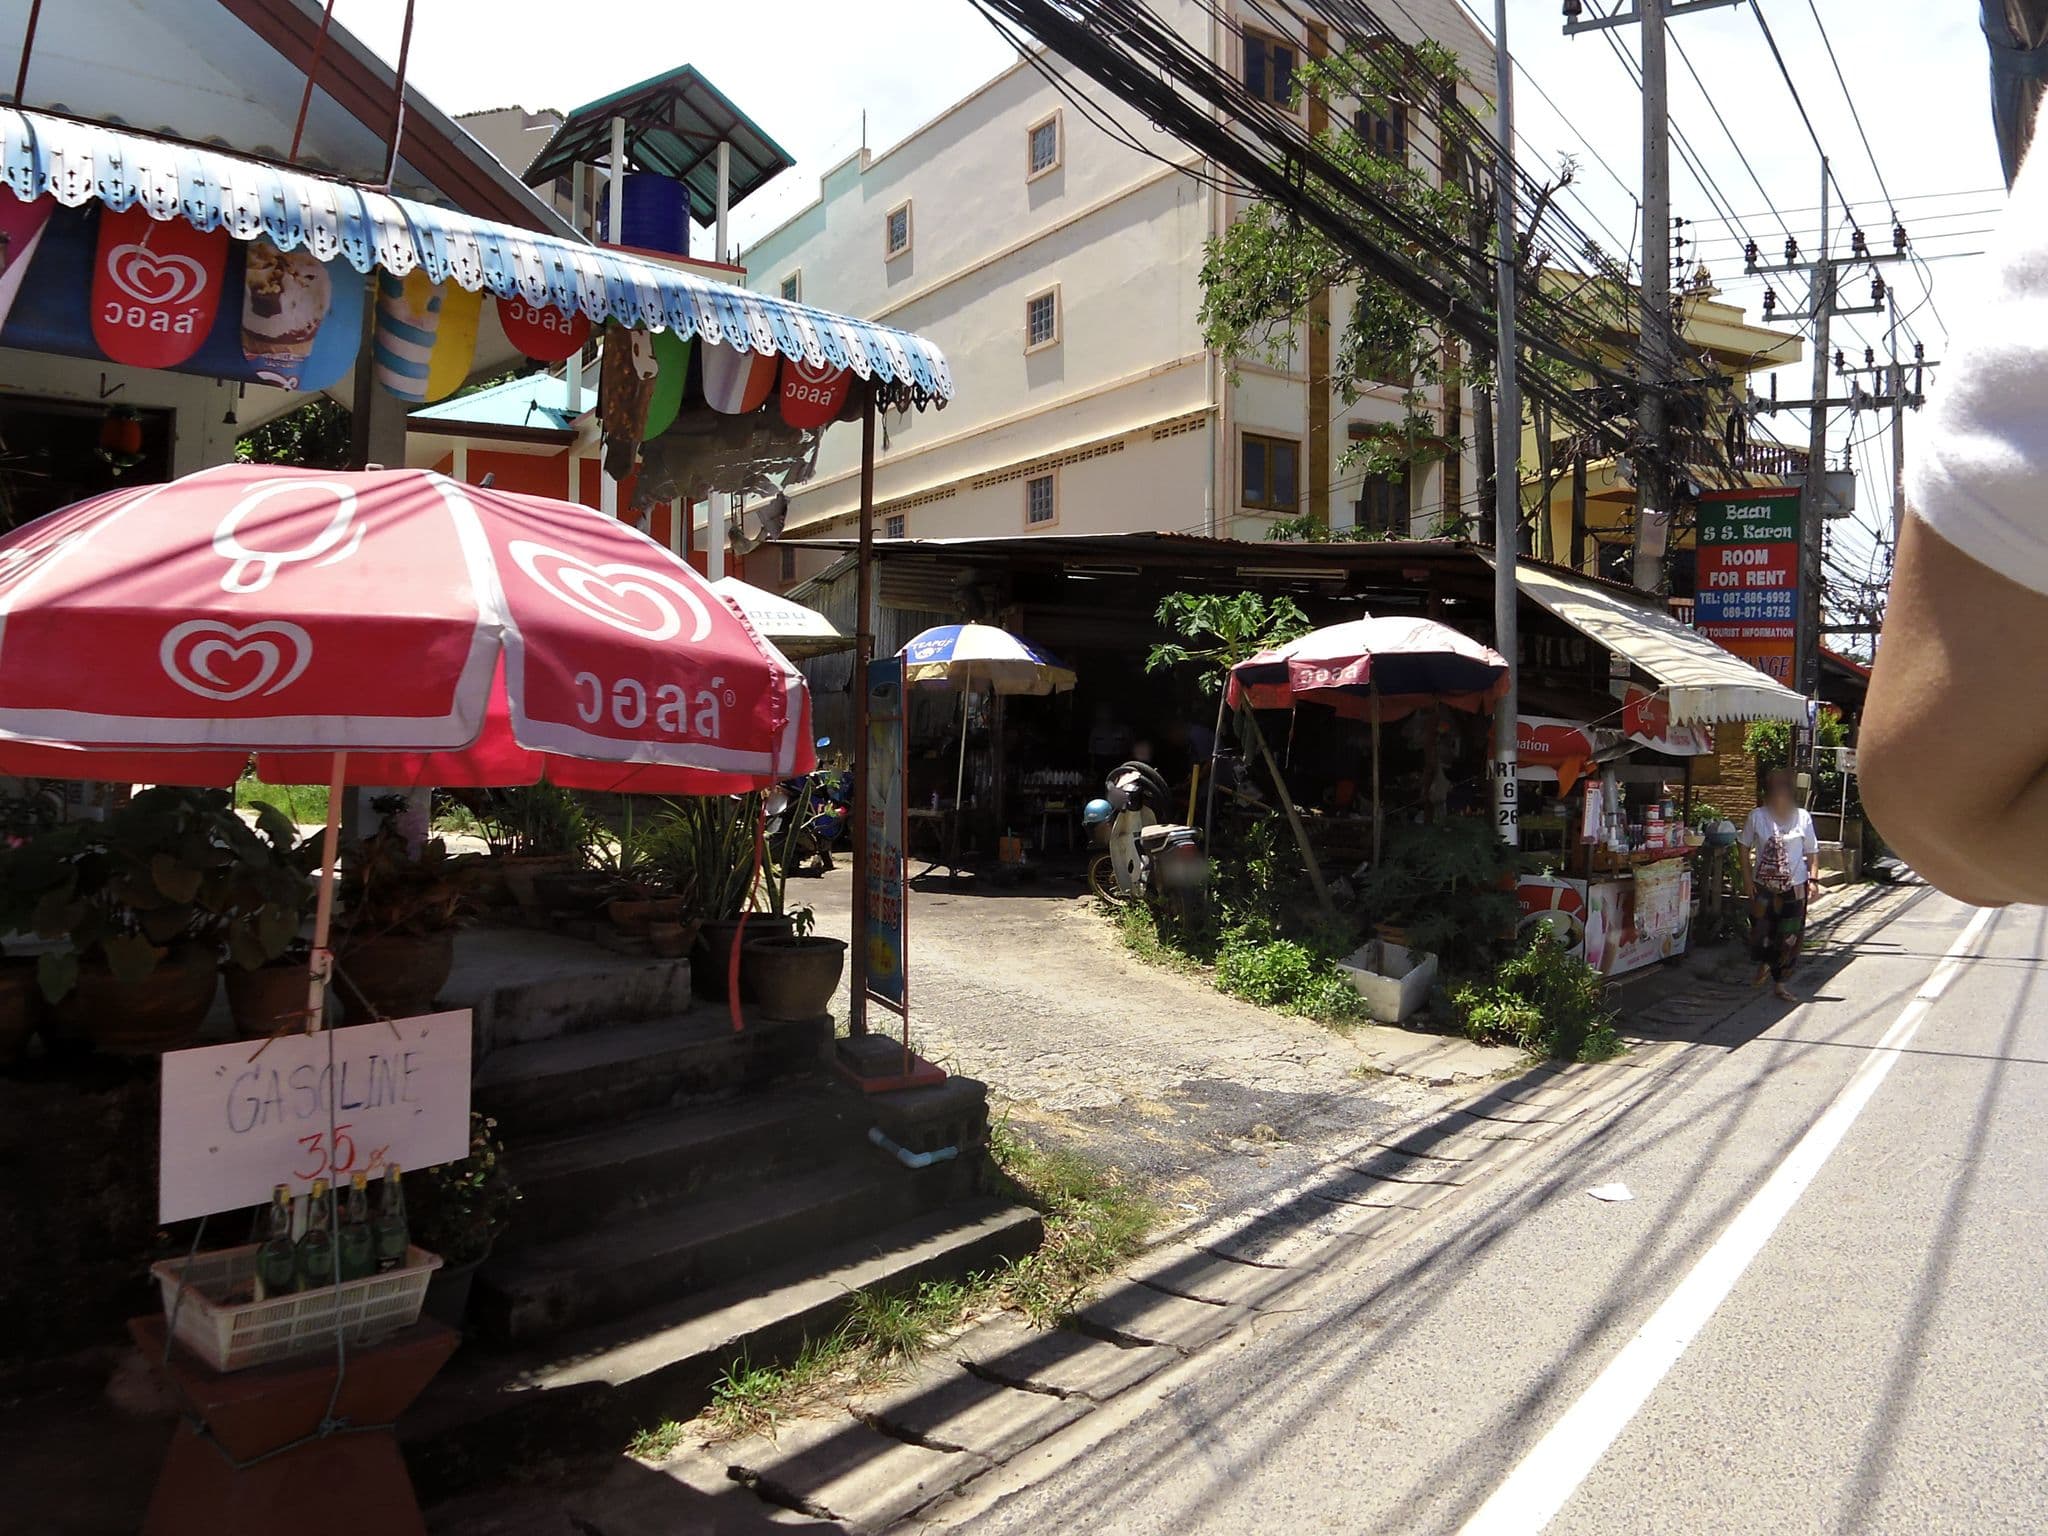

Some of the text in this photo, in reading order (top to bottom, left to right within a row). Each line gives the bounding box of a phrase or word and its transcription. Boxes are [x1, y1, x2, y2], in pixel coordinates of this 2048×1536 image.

[104, 302, 199, 334] วอลล์
[785, 382, 836, 406] วอลล์
[1725, 504, 1771, 520] Baan
[1742, 524, 1792, 539] Karon
[1722, 549, 1769, 566] ROOM
[1709, 570, 1786, 587] FOR RENT
[1700, 592, 1720, 605] TEL:
[1709, 627, 1740, 638] TOURIST
[1742, 627, 1794, 638] INFORMATION
[1503, 782, 1514, 798] 6
[1499, 809, 1518, 826] 26
